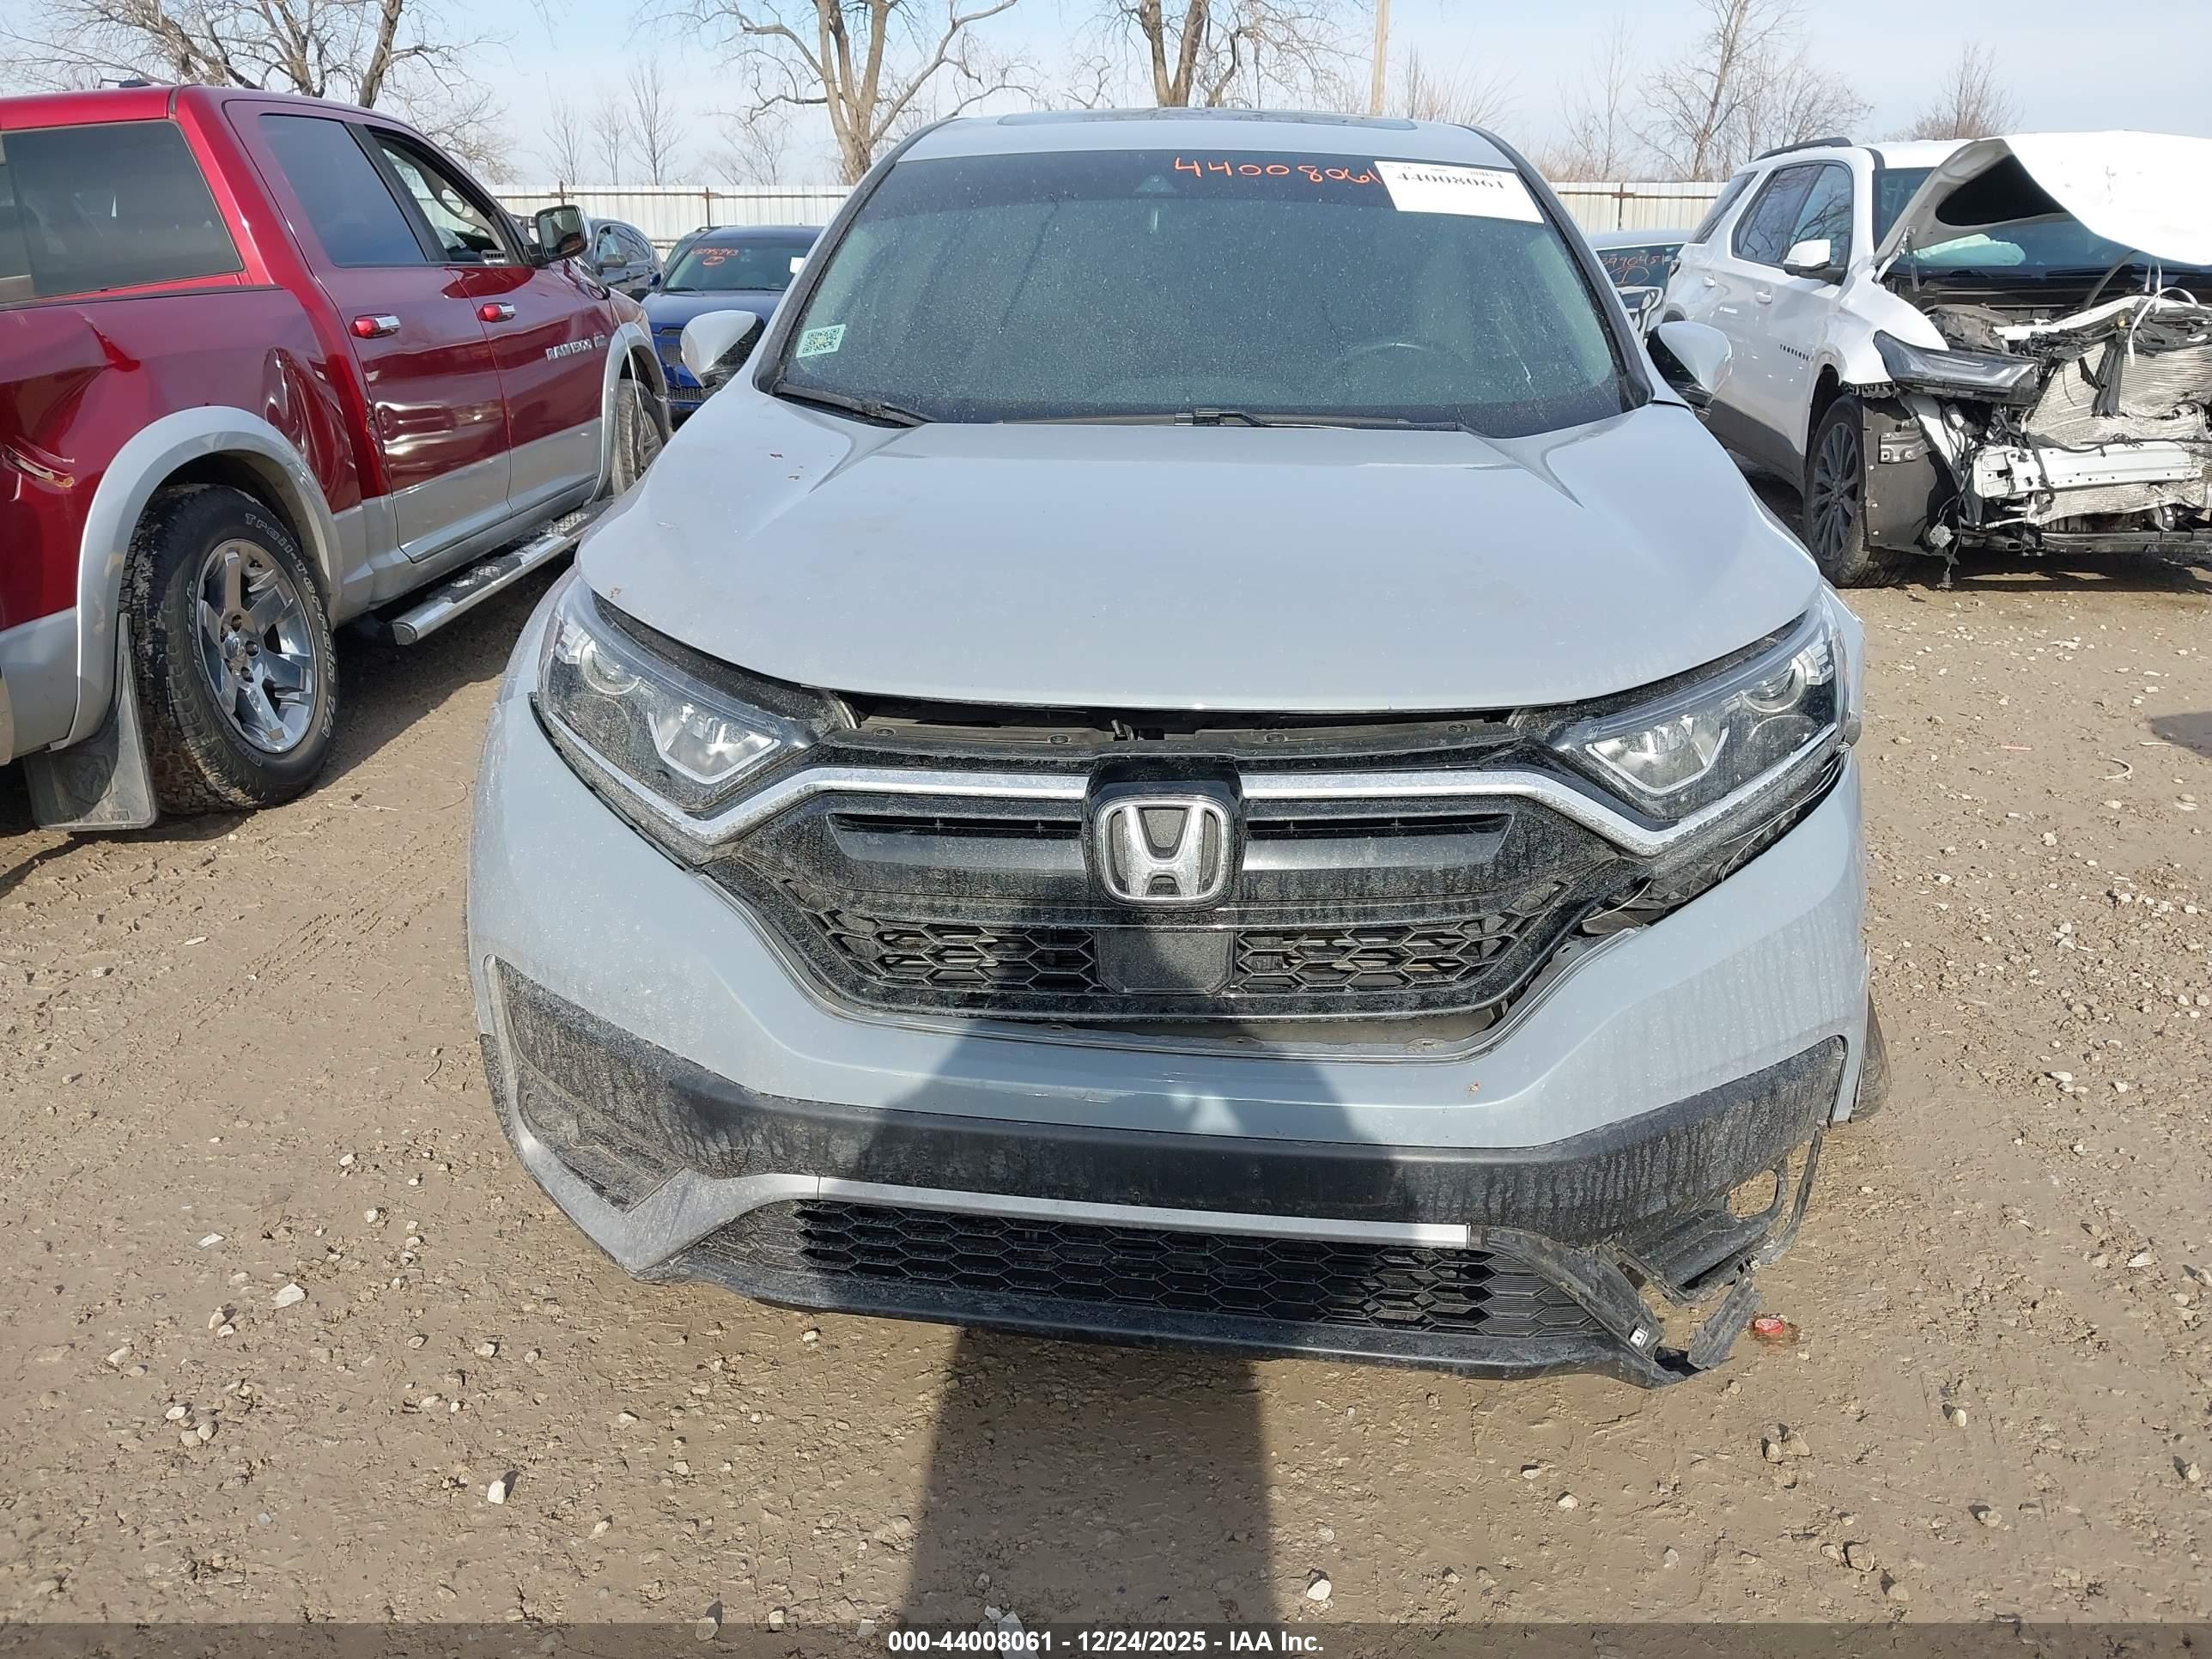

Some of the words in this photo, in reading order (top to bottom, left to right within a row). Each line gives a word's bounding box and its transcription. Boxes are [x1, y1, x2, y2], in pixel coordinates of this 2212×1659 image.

[1174, 156, 1382, 184] 44008061
[1397, 172, 1504, 189] 44008061
[321, 695, 336, 738] T/A
